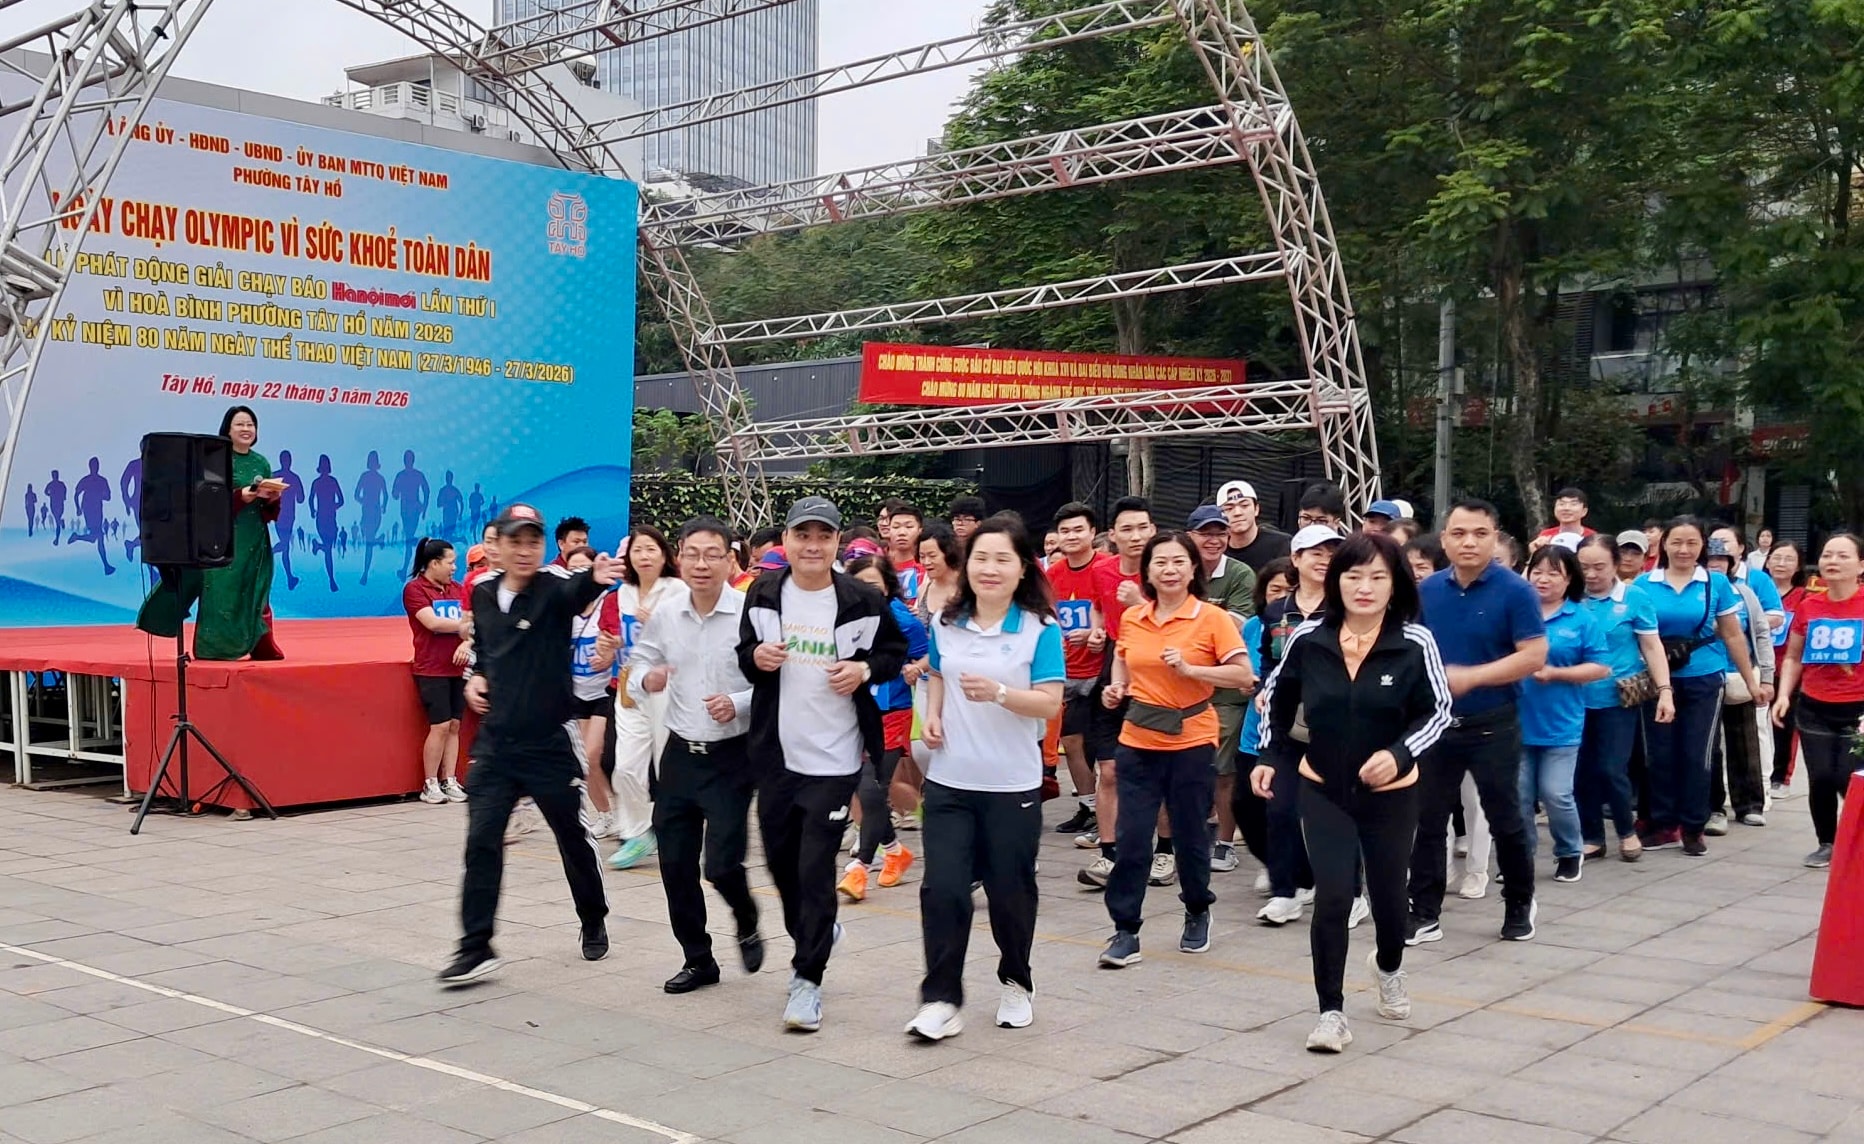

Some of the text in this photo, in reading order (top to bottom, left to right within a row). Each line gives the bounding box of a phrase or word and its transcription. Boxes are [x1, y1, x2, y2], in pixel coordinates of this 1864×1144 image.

[156, 121, 174, 144] ỦY
[190, 132, 230, 154] HĐND
[244, 142, 283, 163] UBND
[296, 145, 314, 167] ỦY
[318, 154, 346, 173] BAN
[350, 159, 385, 180] MTTQ
[388, 165, 415, 186] VIỆT
[419, 171, 448, 189] NAM
[233, 167, 342, 198] PHƯỜNG TÂY HỒ
[121, 200, 178, 248] CHẠY
[185, 209, 274, 254] OLYMPIC
[280, 217, 299, 257] VÌ
[305, 221, 343, 263] SỨC
[349, 227, 397, 270] KHOẺ
[403, 236, 449, 276] TOÀN
[455, 242, 490, 281] DÂN
[75, 251, 129, 278] PHÁT
[134, 256, 189, 285] ĐỘNG
[194, 261, 233, 289] GIẢI
[238, 270, 287, 298] CHẠY
[291, 275, 327, 300] BÁO
[421, 287, 452, 314] LẦN
[456, 295, 488, 317] THỨ
[103, 286, 453, 344] VÌ HOÀ BÌNH PHƯỜNG TÂY HỒ NĂM 2026
[51, 313, 77, 342] KỶ
[82, 318, 132, 350] NIỆM
[136, 326, 160, 348] 80
[164, 326, 206, 352] NĂM
[210, 331, 257, 357] NGÀY
[261, 332, 293, 360] THỂ
[295, 341, 337, 364] THAO
[340, 342, 374, 370] VIỆT
[377, 348, 412, 370] NAM
[417, 352, 492, 376] (27/3/1946
[504, 360, 575, 385] 27/3/2026)
[162, 374, 188, 394] Tây
[221, 380, 260, 399] ngày
[261, 382, 282, 399] 22
[284, 383, 326, 404] tháng
[328, 387, 339, 402] 3
[341, 388, 372, 405] năm
[374, 391, 409, 407] 2026
[1059, 606, 1088, 628] 31
[1810, 625, 1855, 650] 88
